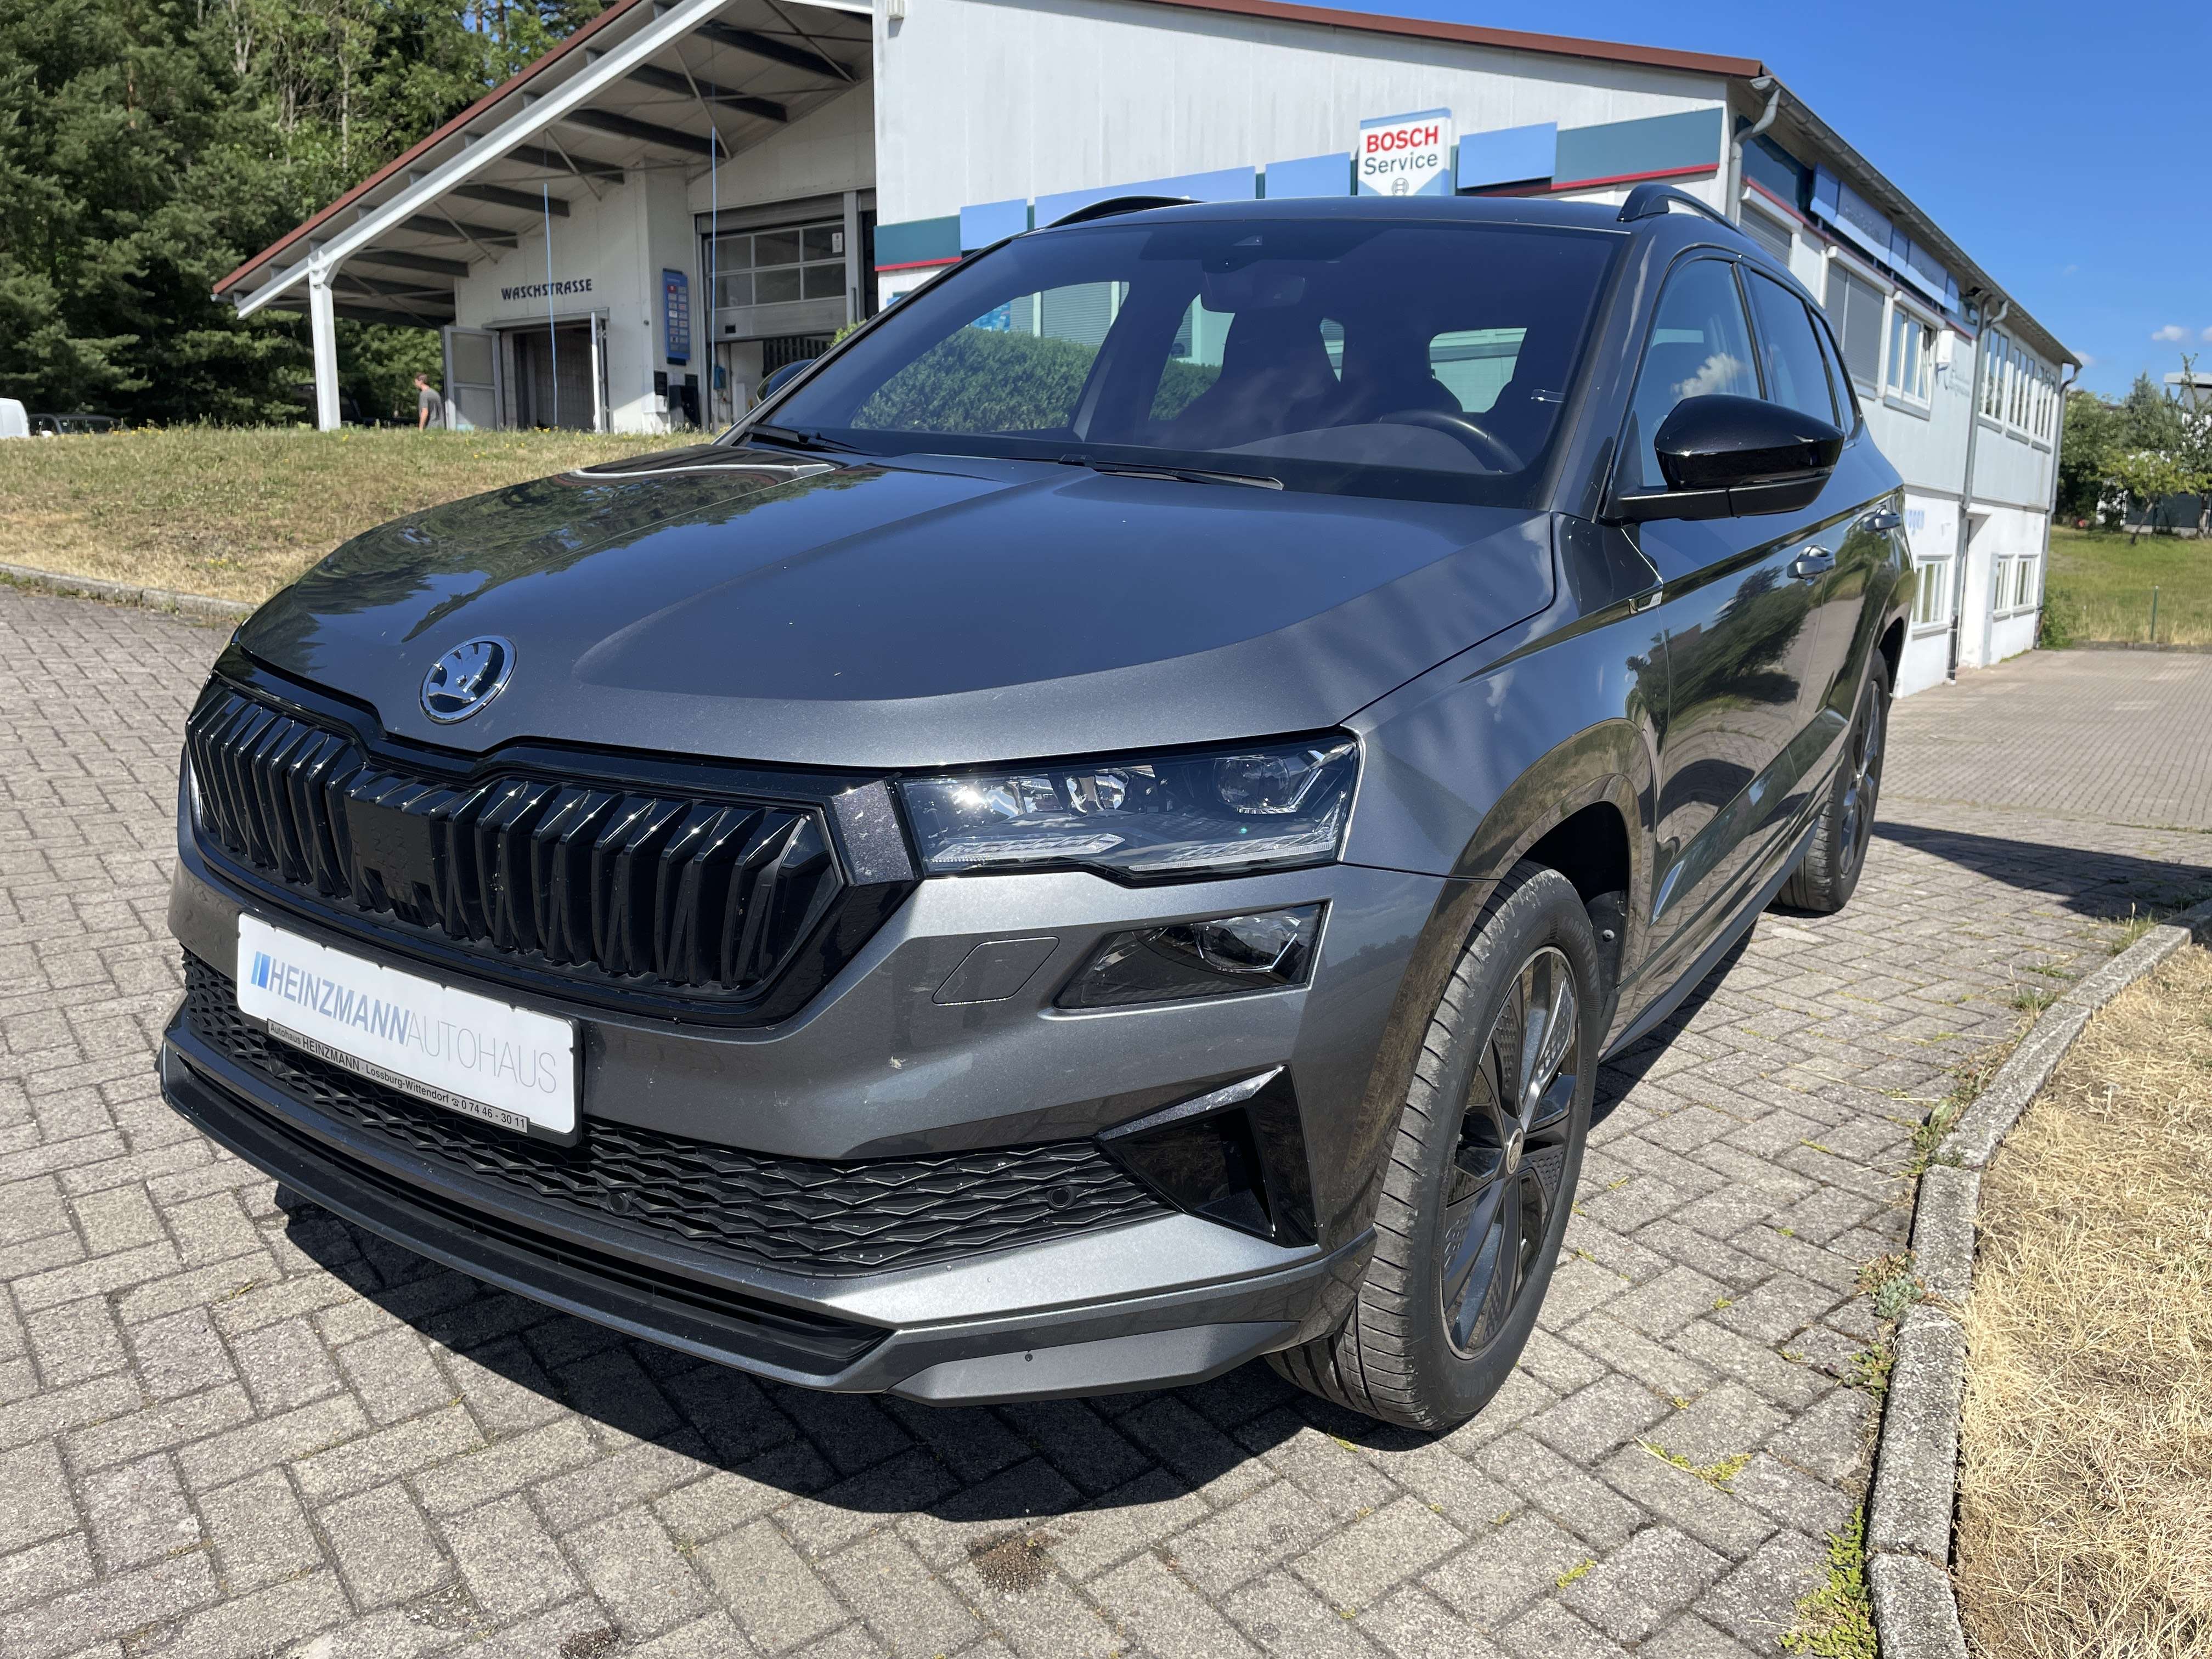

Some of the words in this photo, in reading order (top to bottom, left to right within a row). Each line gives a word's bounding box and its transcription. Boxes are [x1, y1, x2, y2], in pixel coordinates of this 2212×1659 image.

[1366, 126, 1438, 153] BOSCH
[1364, 151, 1437, 175] Service
[501, 278, 592, 301] WASCHSTRASSE
[270, 1023, 301, 1045] Autohaus
[302, 1037, 359, 1071] HEINZMANN
[366, 1064, 449, 1103] Lossburg-Wittendorf
[461, 1099, 466, 1110] 0
[469, 1102, 479, 1114] 74
[482, 1107, 493, 1118] 46
[501, 1113, 512, 1124] 30
[515, 1117, 524, 1128] 11
